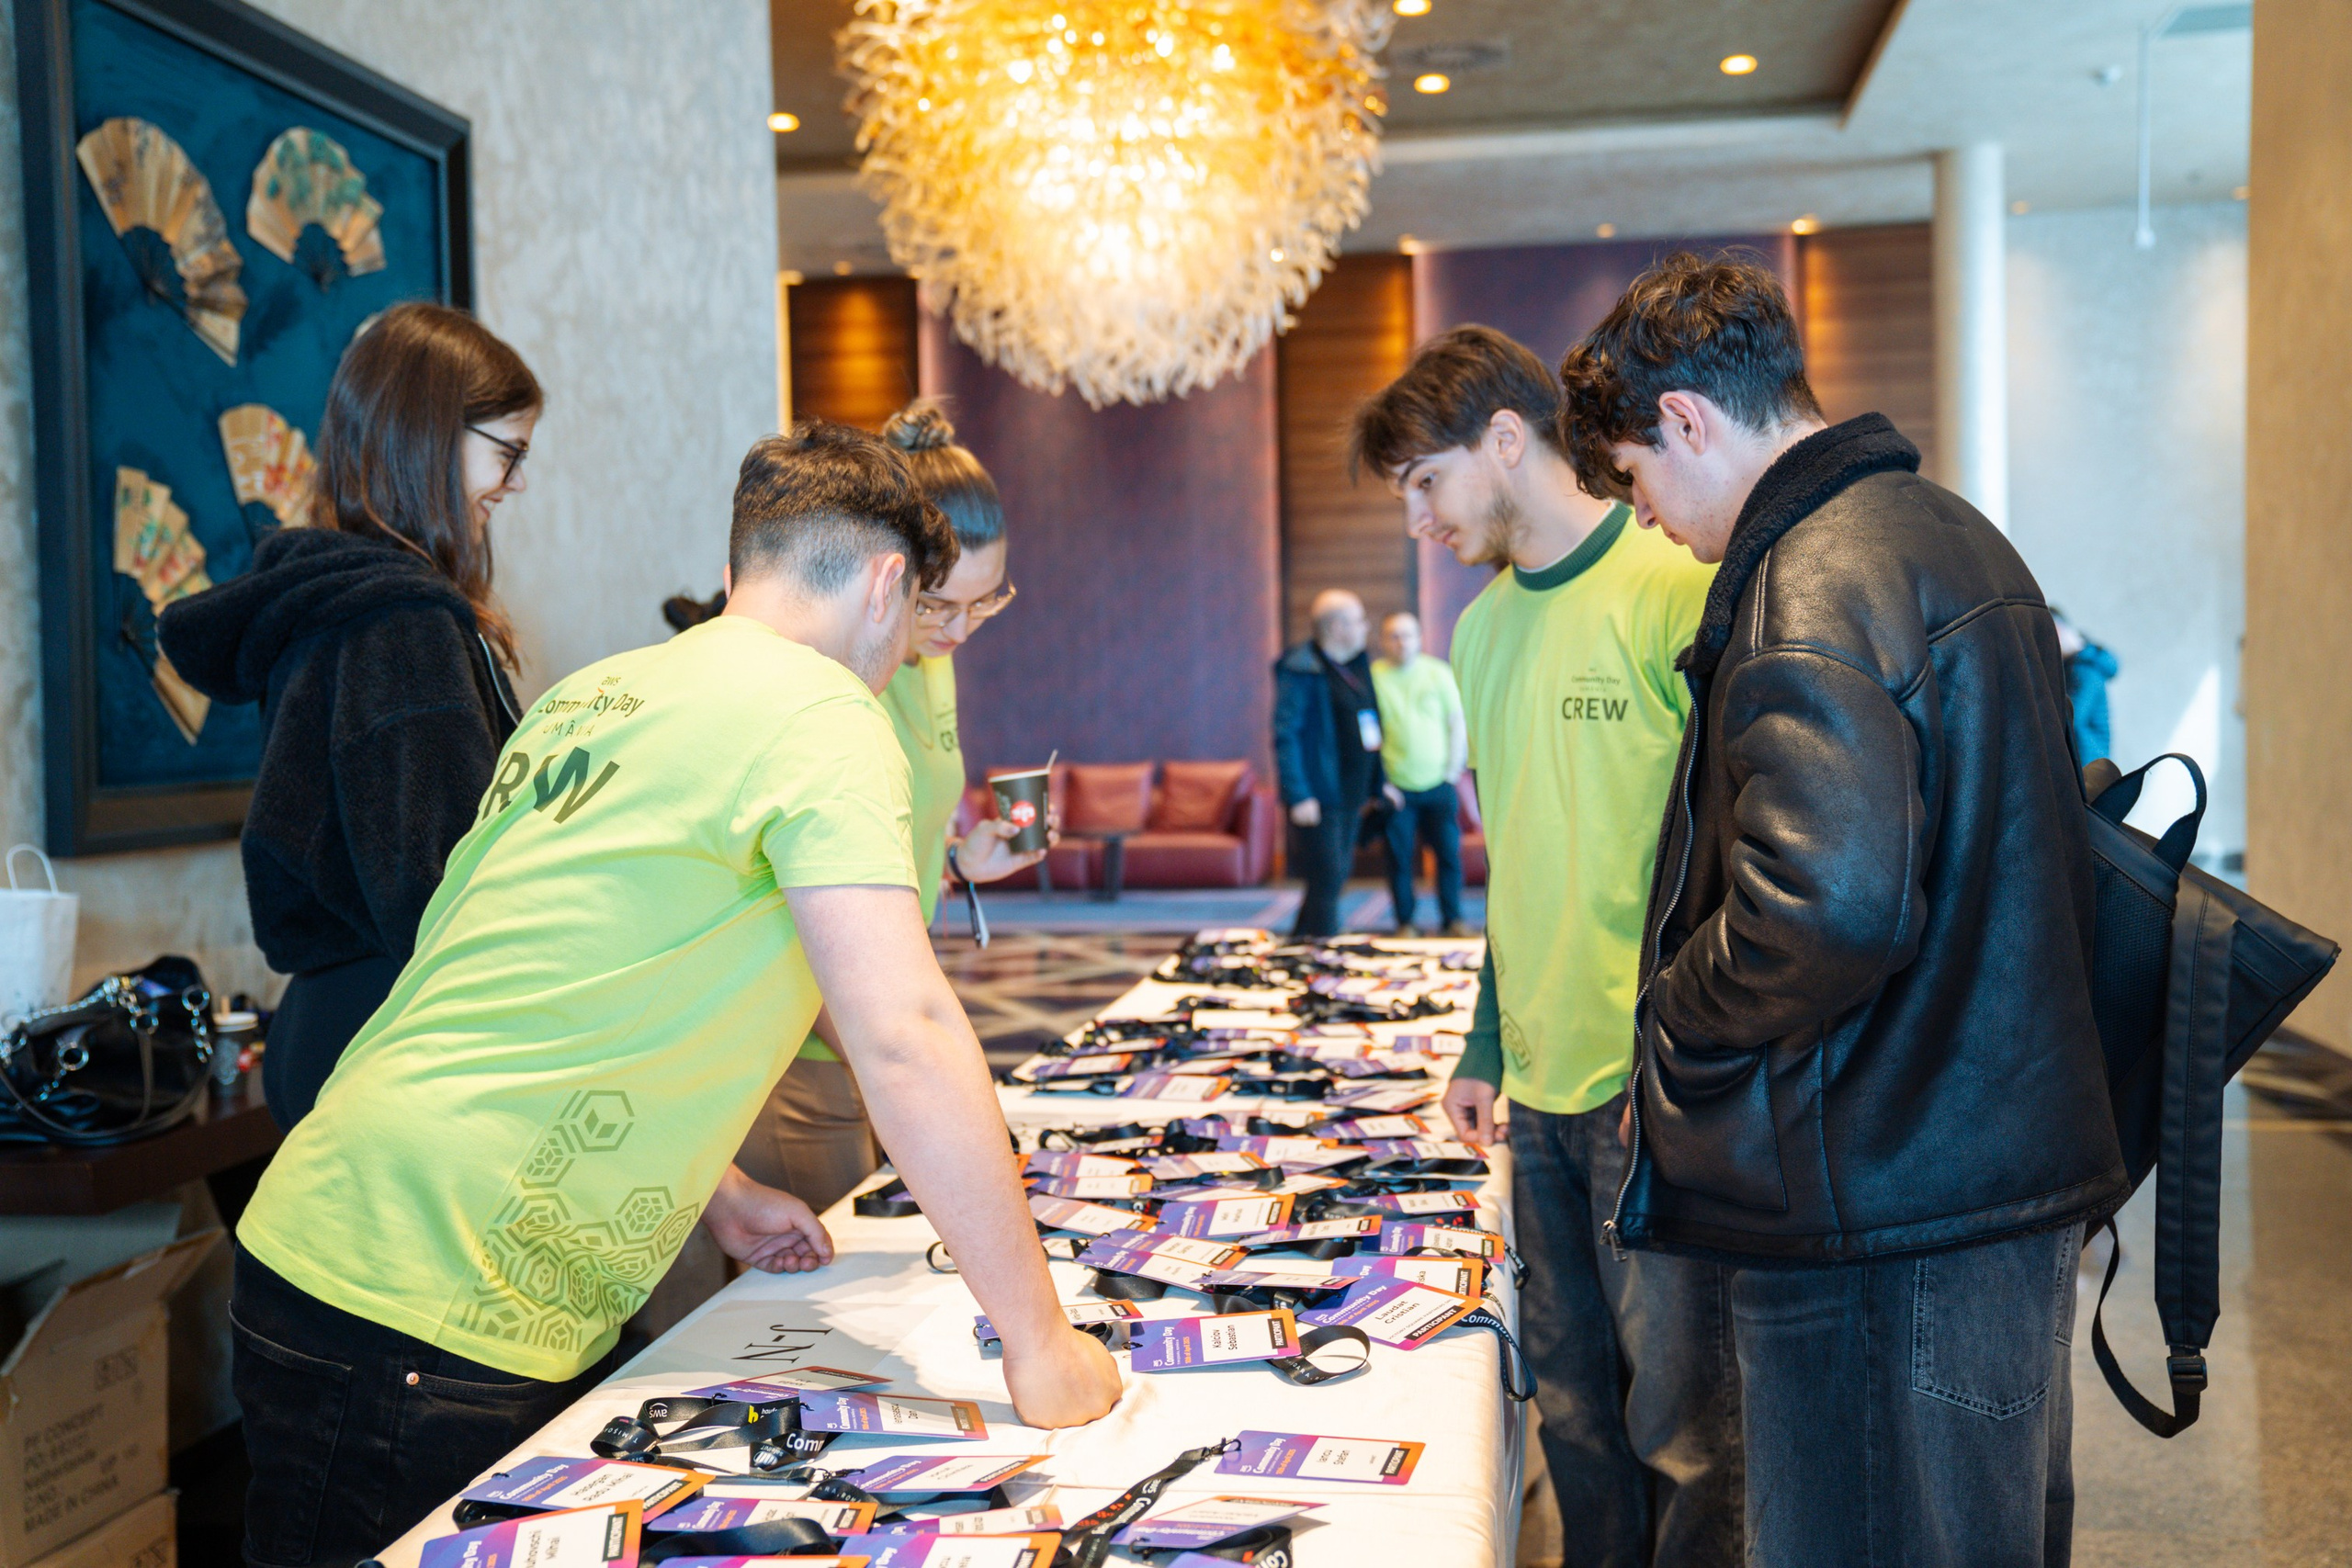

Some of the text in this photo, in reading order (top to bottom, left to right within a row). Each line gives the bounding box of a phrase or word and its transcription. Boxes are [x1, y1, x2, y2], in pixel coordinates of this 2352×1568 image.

[613, 693, 645, 718] Day
[1562, 697, 1628, 722] CREW
[1322, 1292, 1372, 1325] Community
[1368, 1284, 1387, 1302] Day
[1374, 1300, 1408, 1321] Laudat
[1384, 1302, 1420, 1325] Cristian
[1272, 1320, 1284, 1346] PARTICIPANT
[1412, 1308, 1457, 1337] PARTICIPANT
[1162, 1325, 1176, 1366] Community Day
[1212, 1328, 1222, 1348] Kalciov
[1227, 1324, 1238, 1350] Sebastian
[649, 1404, 668, 1419] aws
[836, 1396, 851, 1429] Community Day
[546, 1463, 570, 1473] Day
[1384, 1450, 1406, 1475] PARTICIPANT
